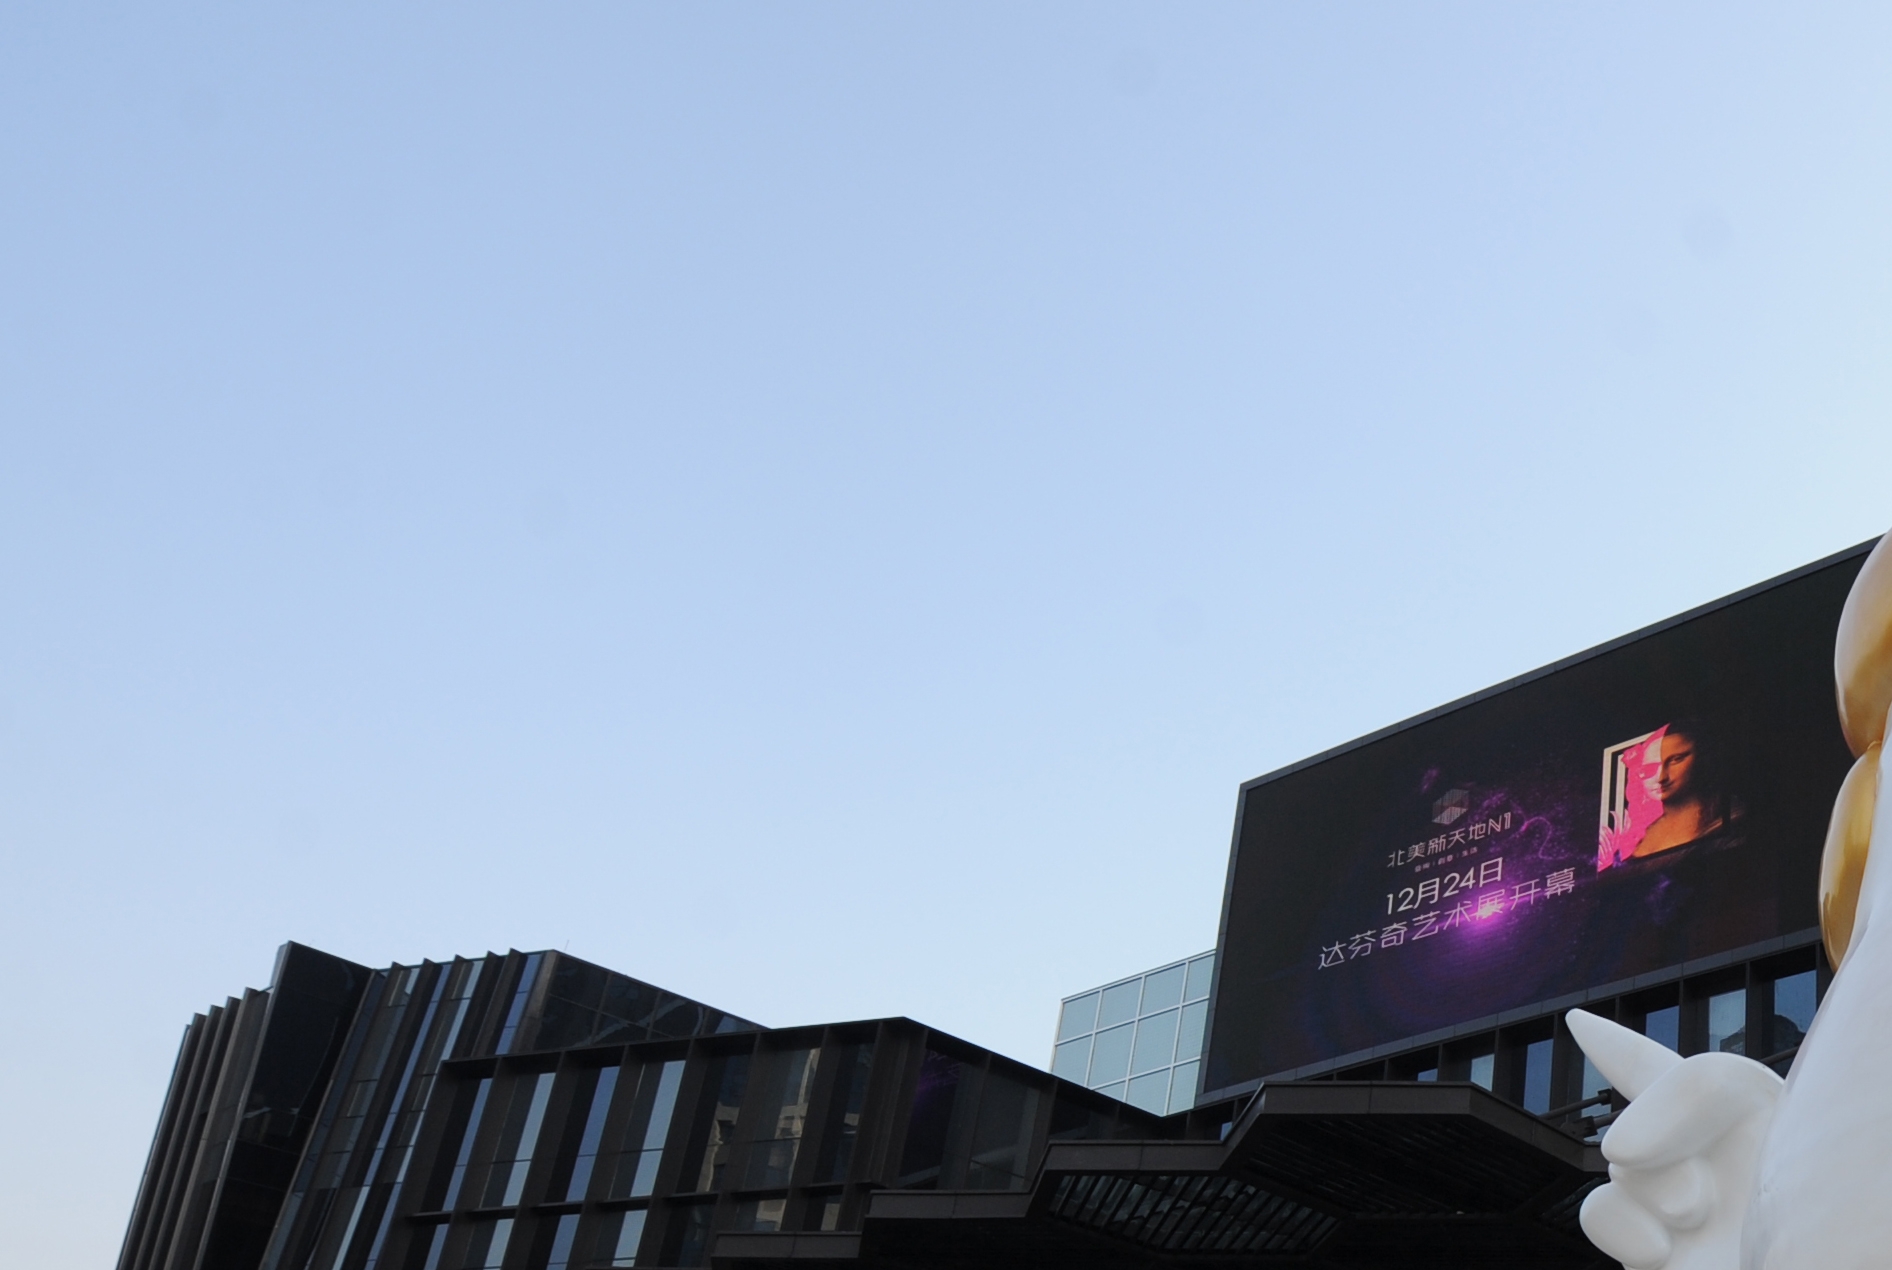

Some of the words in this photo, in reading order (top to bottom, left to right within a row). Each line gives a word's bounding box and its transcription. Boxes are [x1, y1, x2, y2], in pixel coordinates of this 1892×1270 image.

[1318, 867, 1576, 970] 达芬奇艺术展开幕
[1387, 857, 1503, 915] 12月24日
